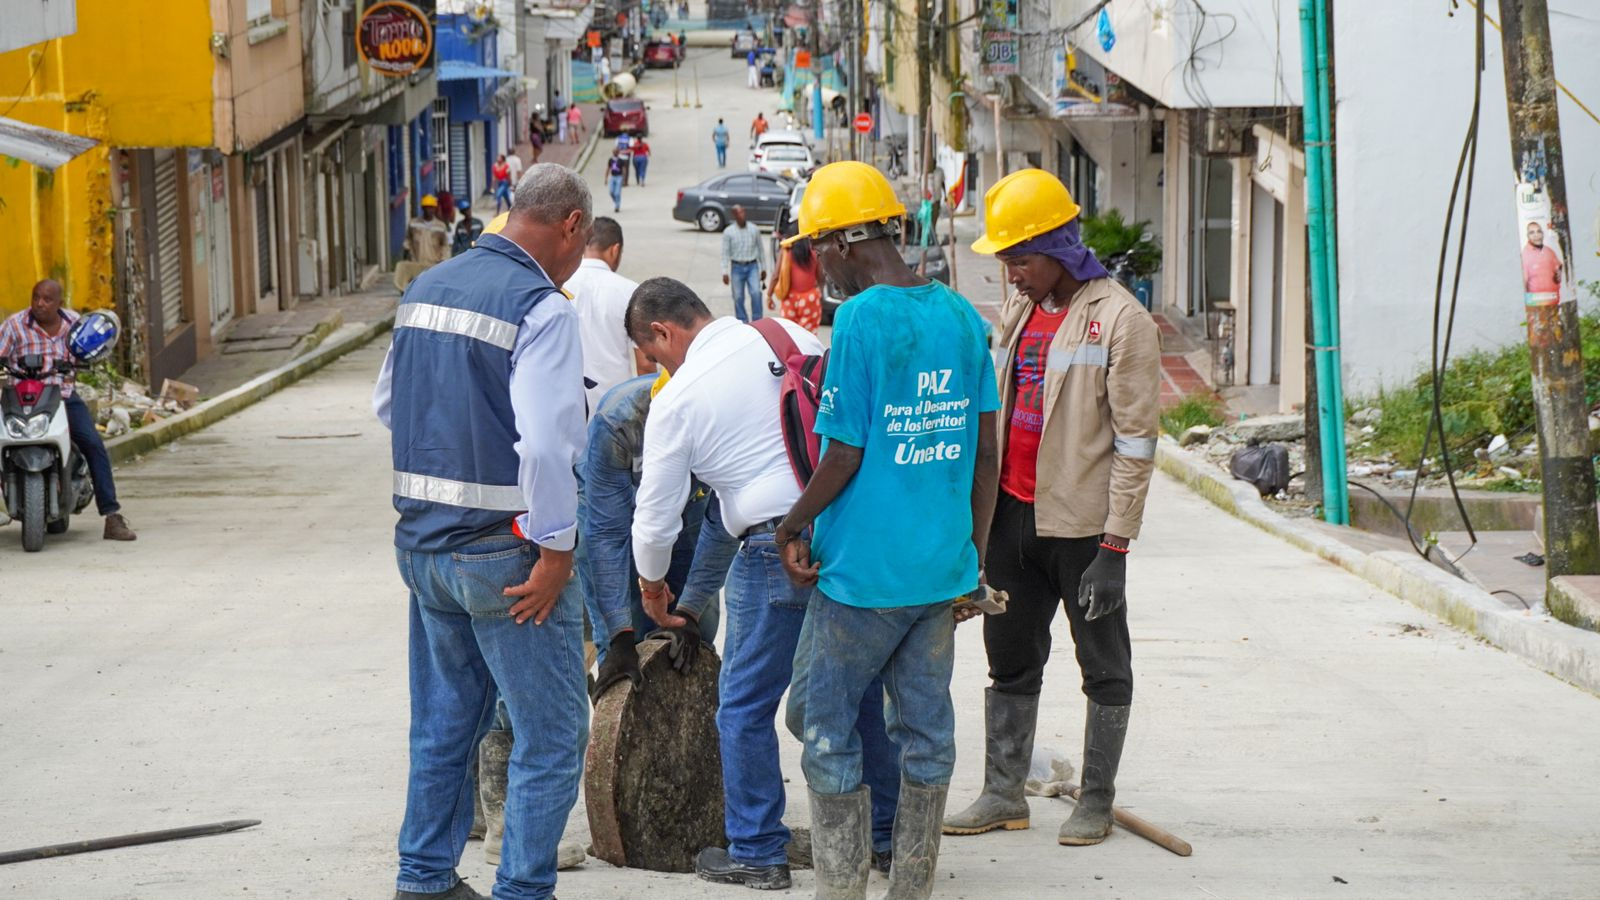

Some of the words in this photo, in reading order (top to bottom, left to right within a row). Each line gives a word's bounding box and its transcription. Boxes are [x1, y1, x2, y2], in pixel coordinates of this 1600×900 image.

[917, 369, 952, 397] PAZ
[884, 404, 913, 417] Para
[915, 400, 923, 415] el
[887, 418, 902, 433] de
[904, 417, 921, 432] los
[895, 437, 961, 465] Únete
